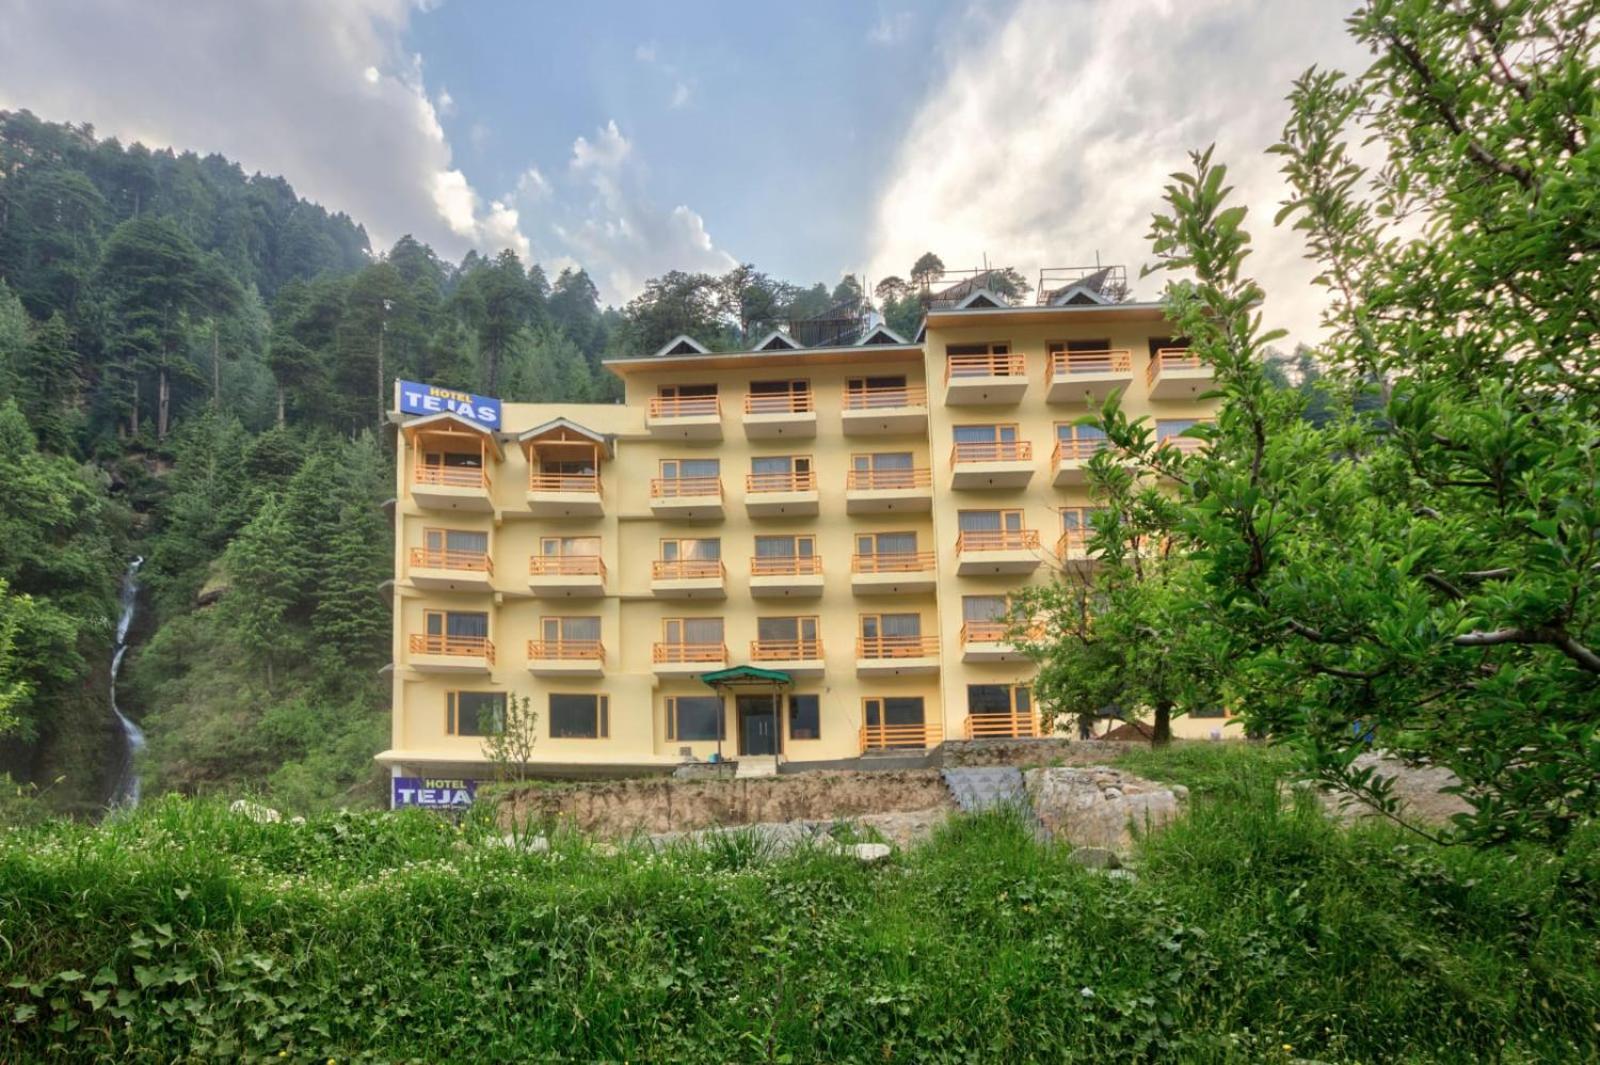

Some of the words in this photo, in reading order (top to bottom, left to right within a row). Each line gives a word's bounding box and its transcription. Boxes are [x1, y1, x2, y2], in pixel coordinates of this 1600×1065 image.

[430, 387, 472, 403] HOTEL
[426, 779, 467, 788] HOTEL
[398, 789, 477, 804] TEJA
